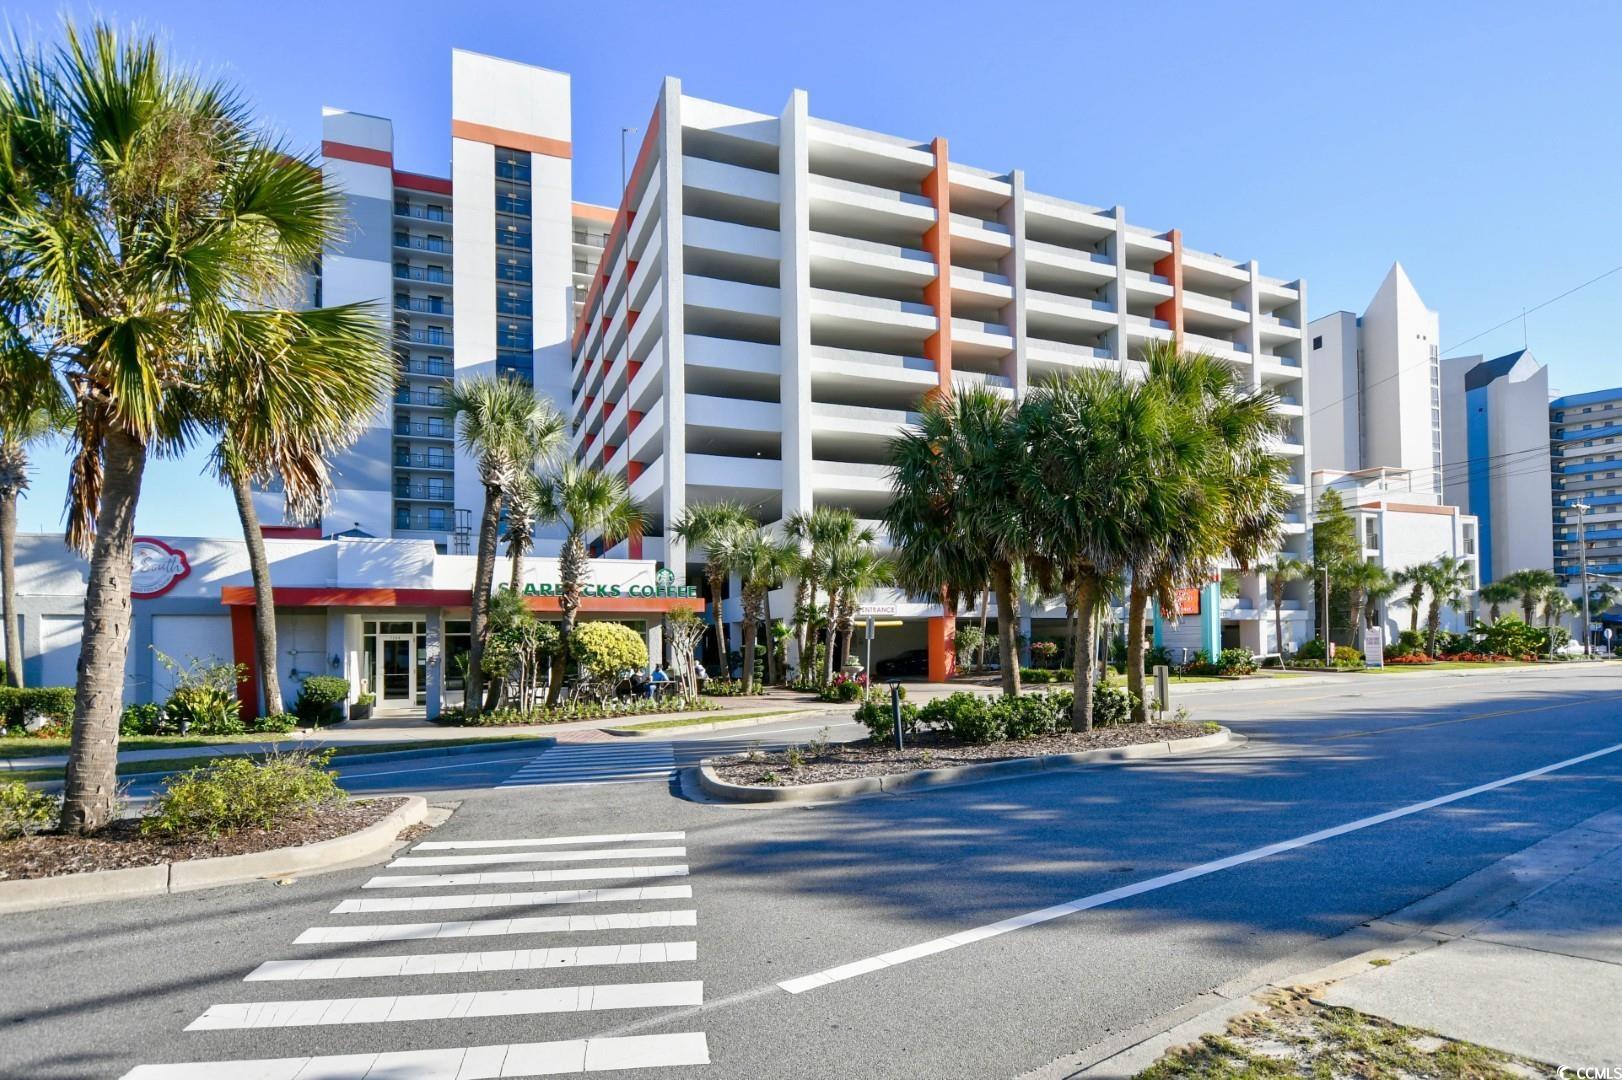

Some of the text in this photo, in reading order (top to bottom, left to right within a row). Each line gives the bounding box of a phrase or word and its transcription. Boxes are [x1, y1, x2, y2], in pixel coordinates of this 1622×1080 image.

[498, 582, 697, 599] SARBCKS COFFEE
[861, 605, 895, 614] ENTRANCE
